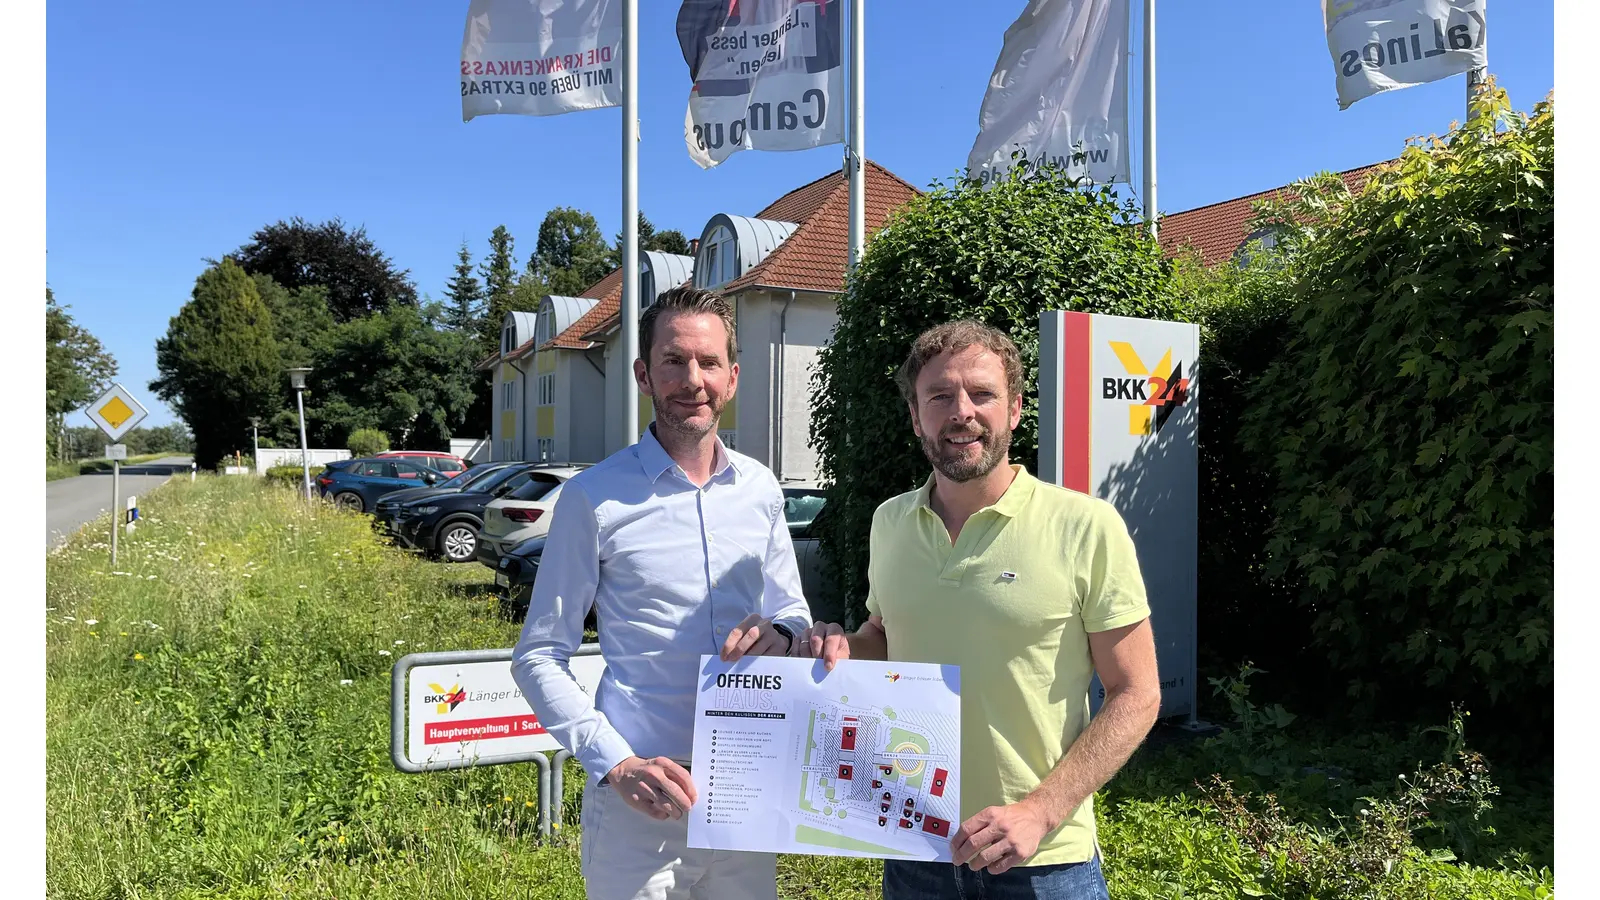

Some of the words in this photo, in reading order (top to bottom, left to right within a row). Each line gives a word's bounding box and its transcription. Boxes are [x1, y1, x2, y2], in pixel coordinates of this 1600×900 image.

[1103, 376, 1189, 406] BKK24
[717, 673, 782, 690] OFFENES
[424, 692, 467, 704] BKK24
[469, 688, 511, 702] Länger
[715, 689, 777, 710] HAUS.
[430, 724, 509, 738] Hauptverwaltung
